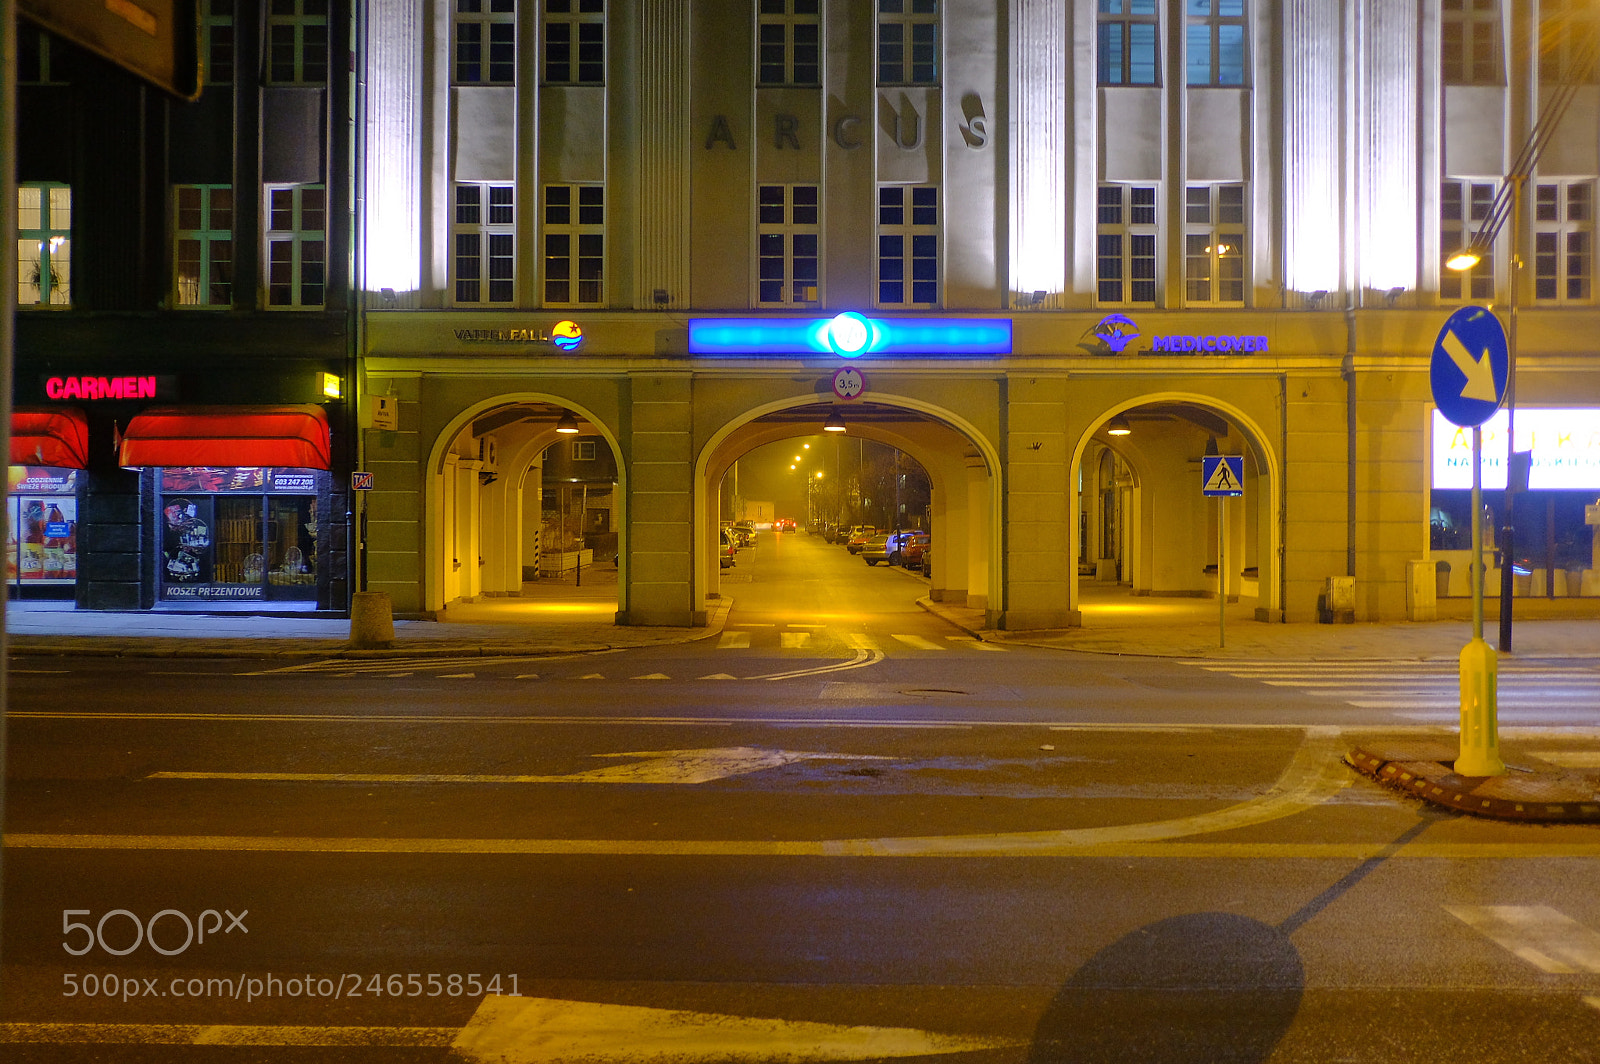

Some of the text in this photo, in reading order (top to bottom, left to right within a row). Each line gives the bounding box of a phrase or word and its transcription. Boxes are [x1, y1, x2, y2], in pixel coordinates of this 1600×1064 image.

[705, 114, 989, 151] ARCUS
[1152, 335, 1269, 352] MEDICOVER
[46, 376, 156, 400] CARMEN
[274, 478, 288, 486] 603
[287, 478, 301, 486] 247
[354, 474, 372, 488] TAXI
[166, 587, 262, 596] KOSZE PREZENTOWE
